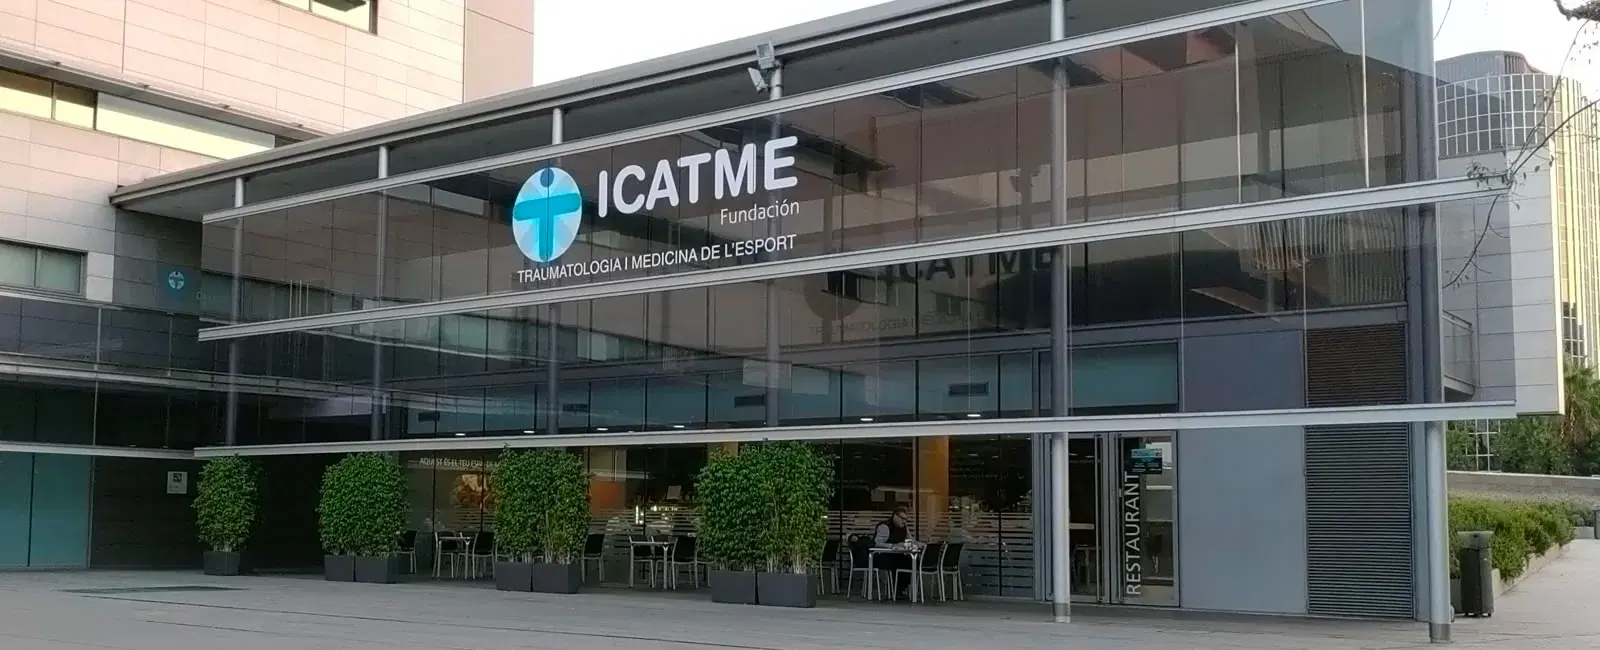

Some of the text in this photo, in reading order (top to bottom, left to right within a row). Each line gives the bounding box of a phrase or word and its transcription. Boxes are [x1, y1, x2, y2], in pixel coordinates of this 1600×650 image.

[598, 135, 799, 218] ICATME
[720, 199, 800, 225] Fundación
[517, 234, 797, 283] TRAUMATOLOGIA I MEDICINA DE L'ESPORT
[1124, 471, 1142, 595] RESTAURANT
